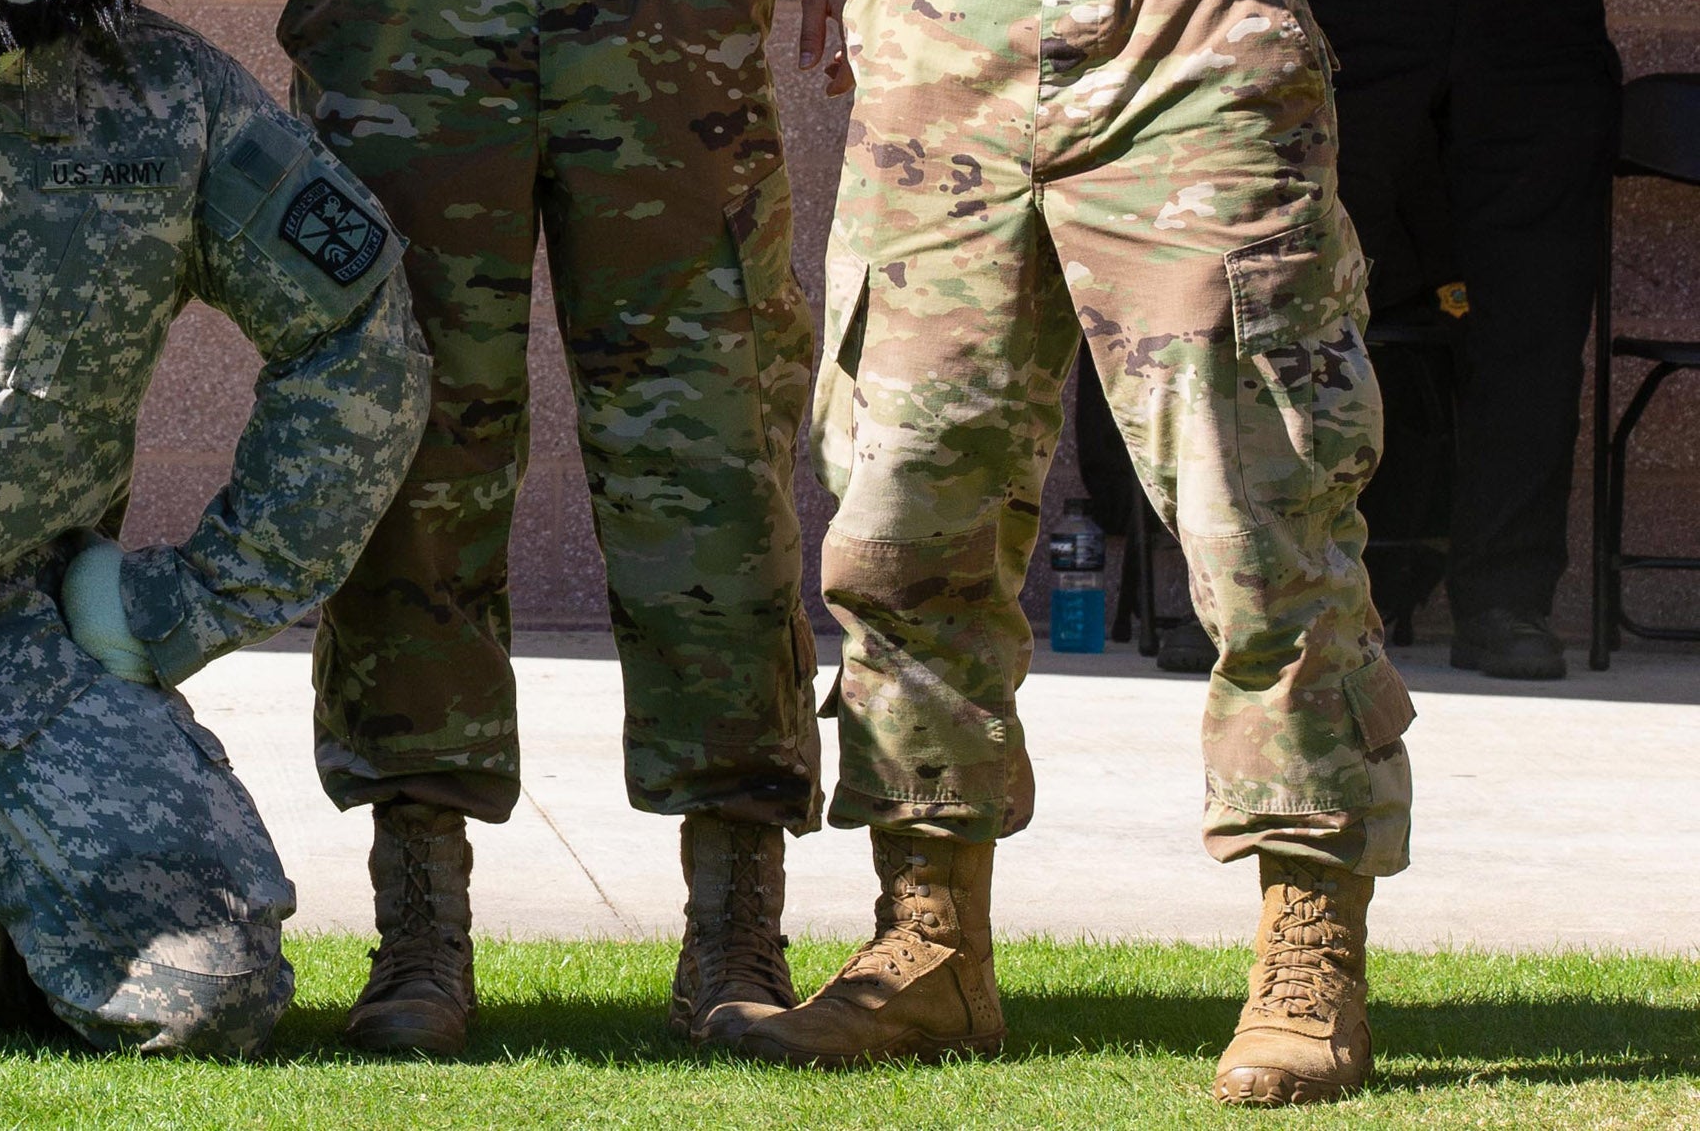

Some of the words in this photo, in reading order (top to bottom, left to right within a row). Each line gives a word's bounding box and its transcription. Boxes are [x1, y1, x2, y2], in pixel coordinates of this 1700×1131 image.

[52, 162, 93, 185] U.S.
[101, 162, 165, 185] ARMY
[339, 227, 381, 279] EXCELLENCE
